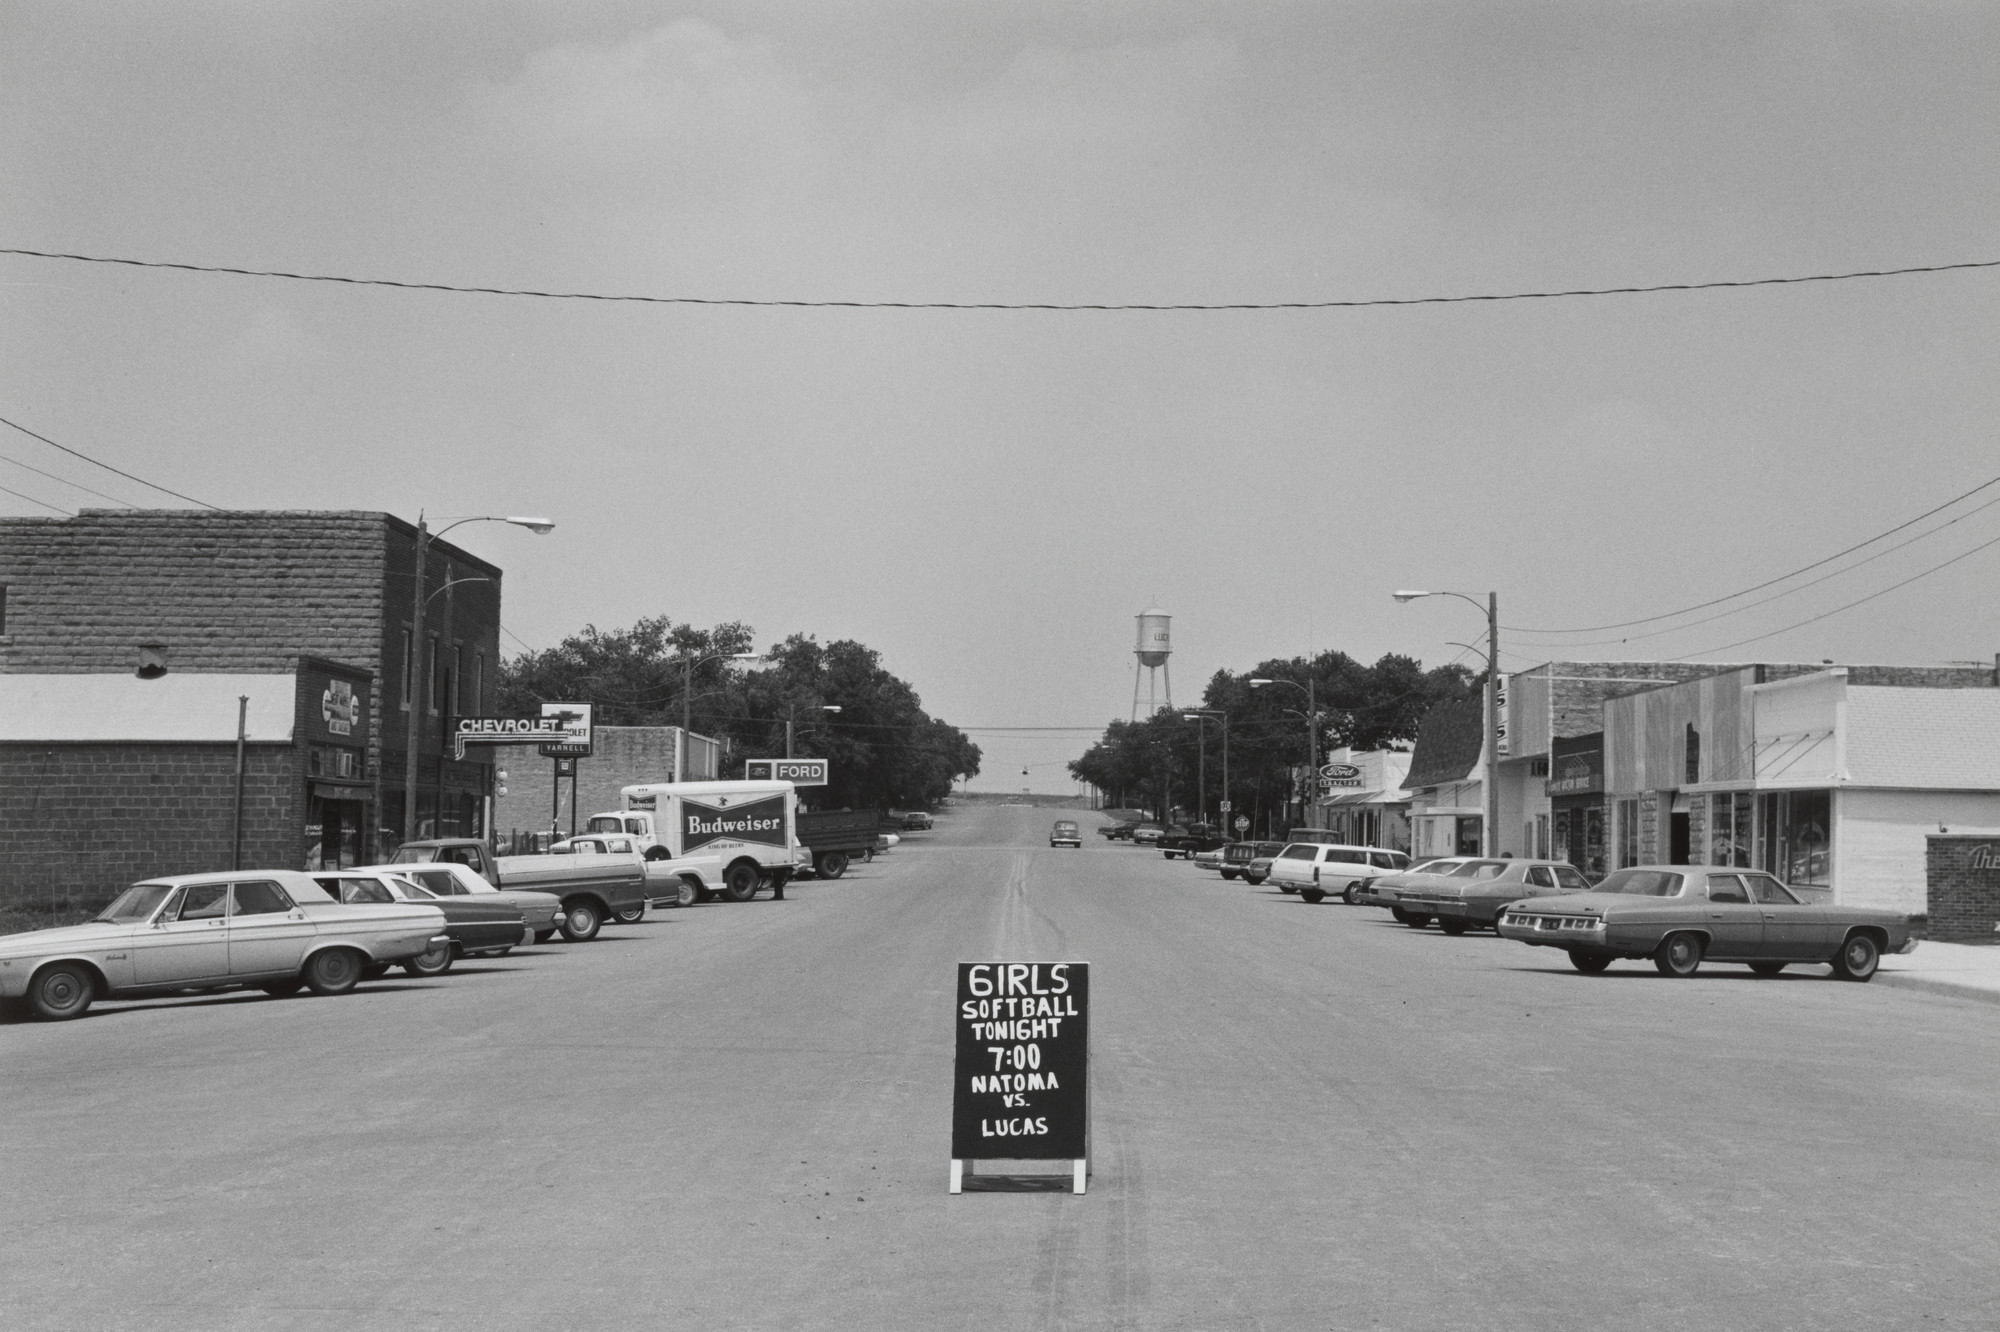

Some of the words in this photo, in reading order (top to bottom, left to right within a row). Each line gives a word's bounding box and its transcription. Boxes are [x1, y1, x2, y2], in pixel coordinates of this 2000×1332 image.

[460, 719, 559, 732] CHEVROLET
[780, 766, 821, 777] FORD
[1326, 766, 1354, 776] Ford
[629, 799, 656, 809] Budweiser
[688, 815, 780, 834] Budweiser
[1967, 844, 2000, 869] The
[969, 964, 1069, 996] GIRLS
[962, 995, 1078, 1019] SOFTBALL
[971, 1018, 1062, 1040] TONIGHT
[988, 1043, 1041, 1071] 7:00
[972, 1072, 1059, 1093] NATOMA
[982, 1117, 1048, 1137] LUCAS
